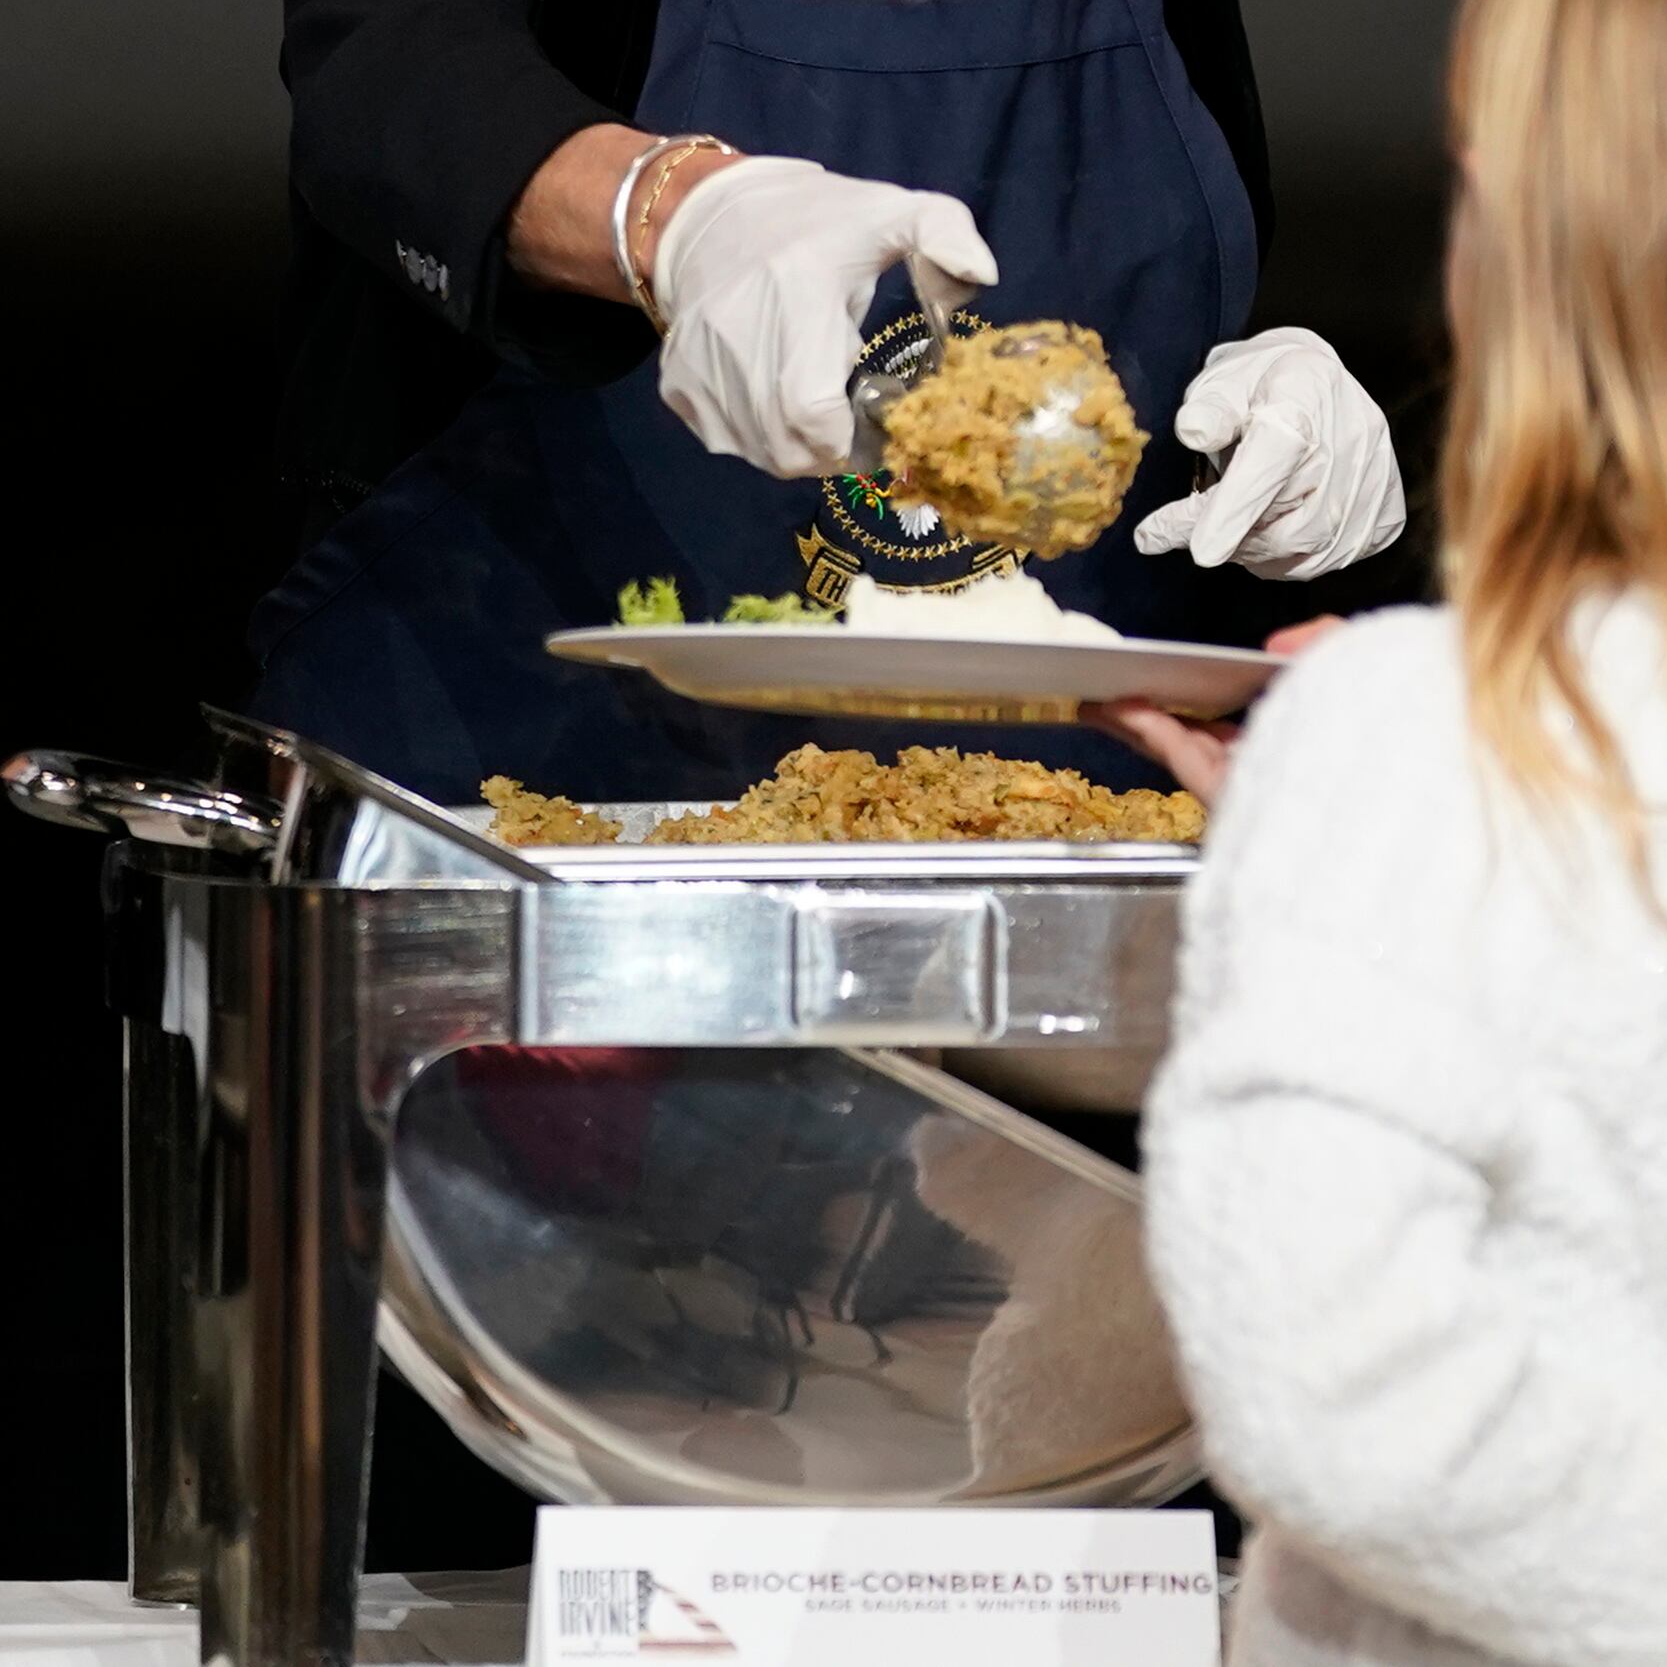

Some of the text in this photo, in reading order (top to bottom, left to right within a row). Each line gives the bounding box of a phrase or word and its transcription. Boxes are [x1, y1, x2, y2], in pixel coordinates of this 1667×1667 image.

[815, 566, 849, 603] TH
[711, 1573, 1214, 1595] BRIOCHE-CORNBREAD STUFFING
[558, 1602, 636, 1637] IRVINE
[805, 1599, 852, 1613] SAGE
[862, 1599, 948, 1613] SAUSAGE
[976, 1599, 1052, 1614] WINTER
[1058, 1599, 1122, 1614] HERBS
